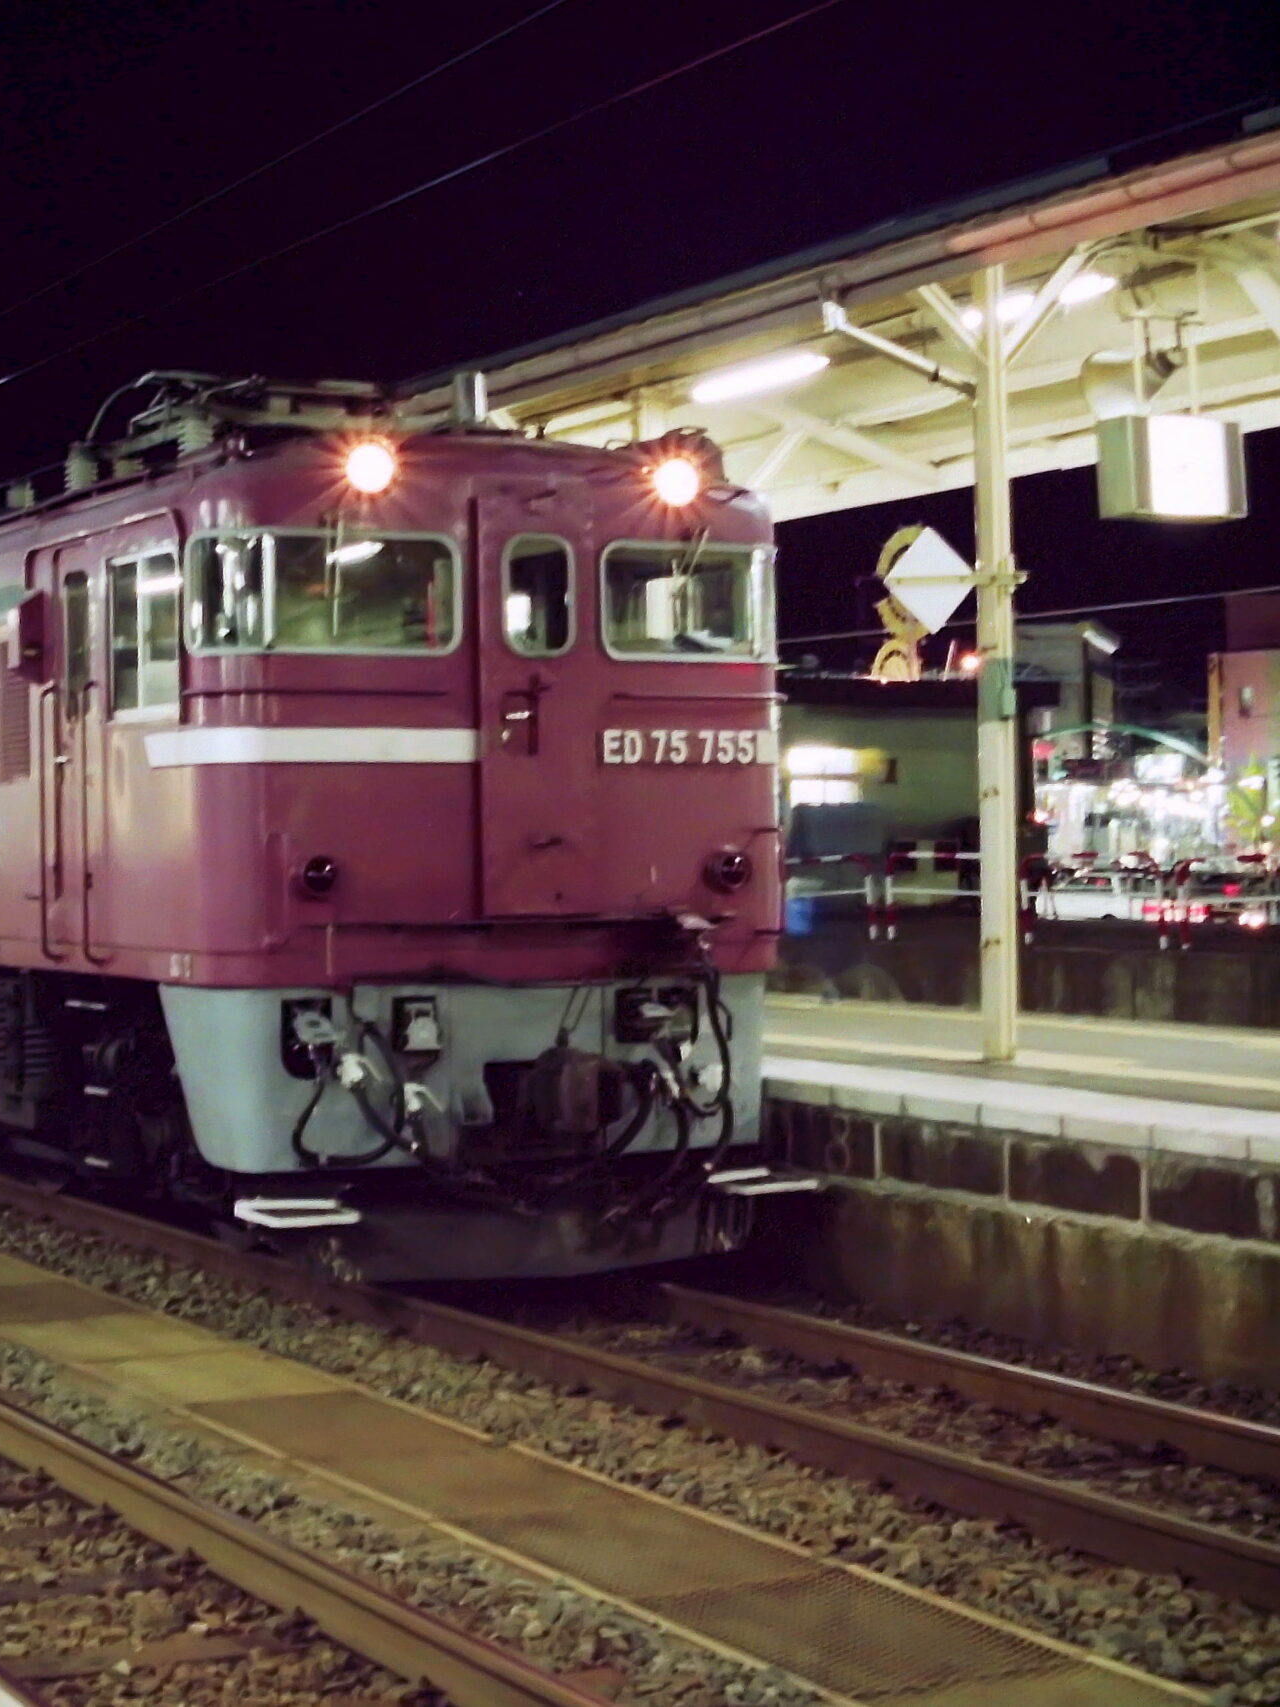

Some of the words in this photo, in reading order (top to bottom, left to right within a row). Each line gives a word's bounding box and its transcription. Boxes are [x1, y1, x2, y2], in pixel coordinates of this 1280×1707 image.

[603, 729, 643, 764] ED
[650, 729, 688, 764] 75
[698, 729, 754, 764] 755
